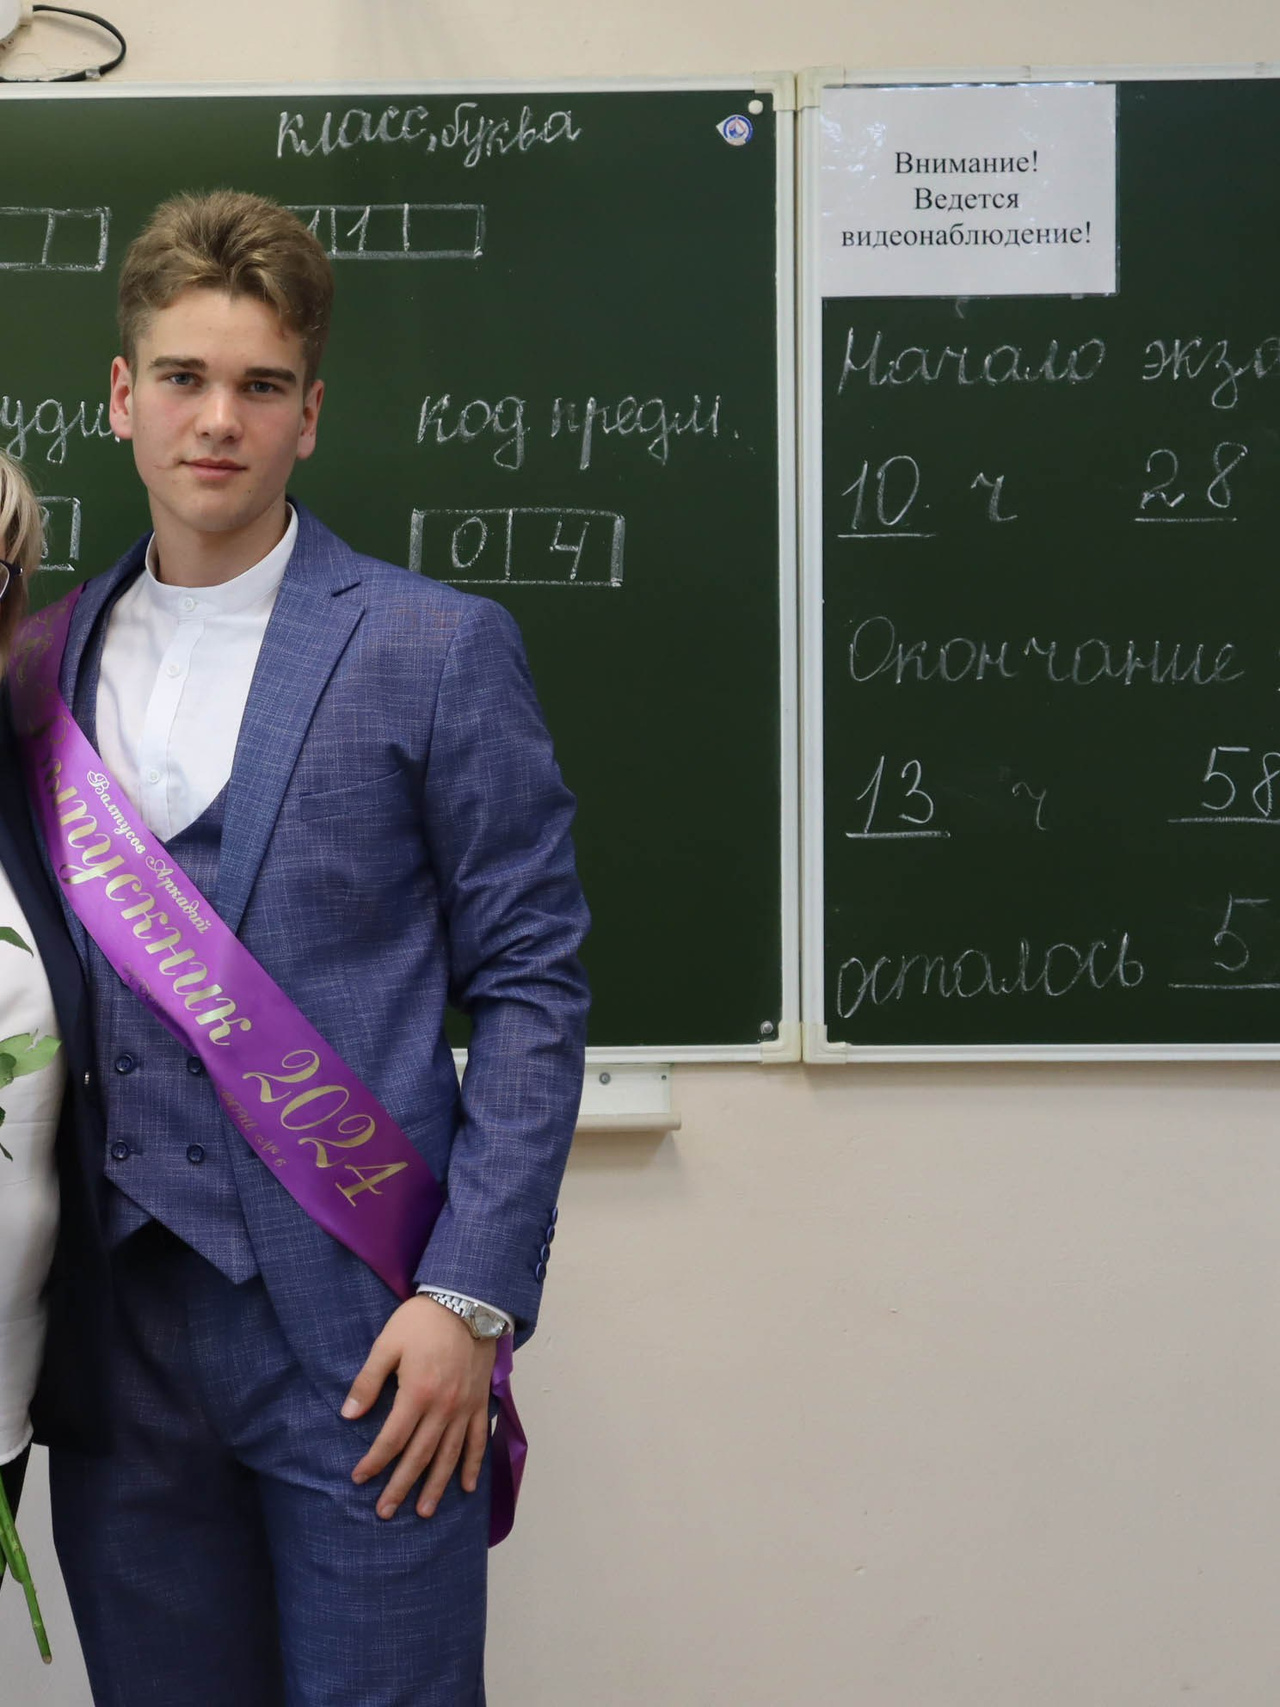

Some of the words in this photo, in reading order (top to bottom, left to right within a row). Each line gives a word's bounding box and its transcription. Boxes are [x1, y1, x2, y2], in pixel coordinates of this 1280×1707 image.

[894, 151, 1039, 174] Внимание!
[913, 188, 1020, 211] Ведется
[841, 222, 1093, 249] видеонаблюдение!
[416, 392, 527, 472] код
[242, 1048, 410, 1208] 2024
